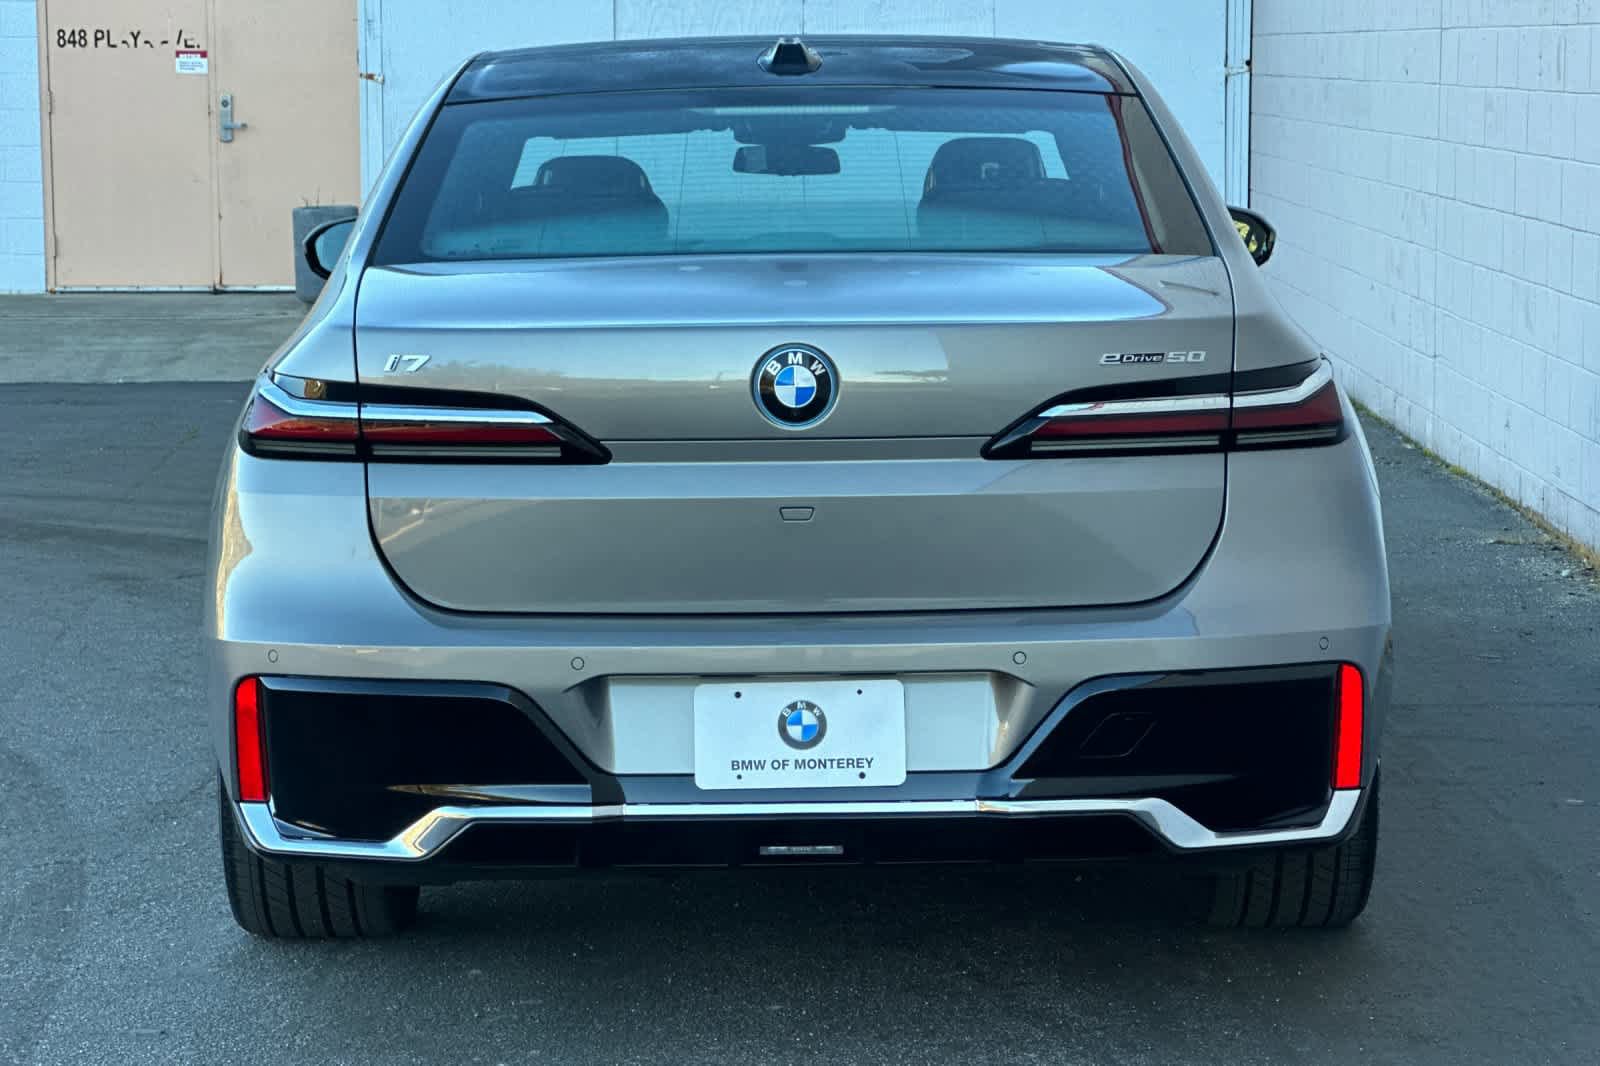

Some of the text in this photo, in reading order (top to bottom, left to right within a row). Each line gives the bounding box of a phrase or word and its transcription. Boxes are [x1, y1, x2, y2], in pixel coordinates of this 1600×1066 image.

[56, 28, 87, 48] 848
[383, 354, 432, 372] i7
[766, 351, 826, 376] BMW
[782, 701, 822, 717] BMW
[731, 757, 874, 771] BMW OF MONTEREY
